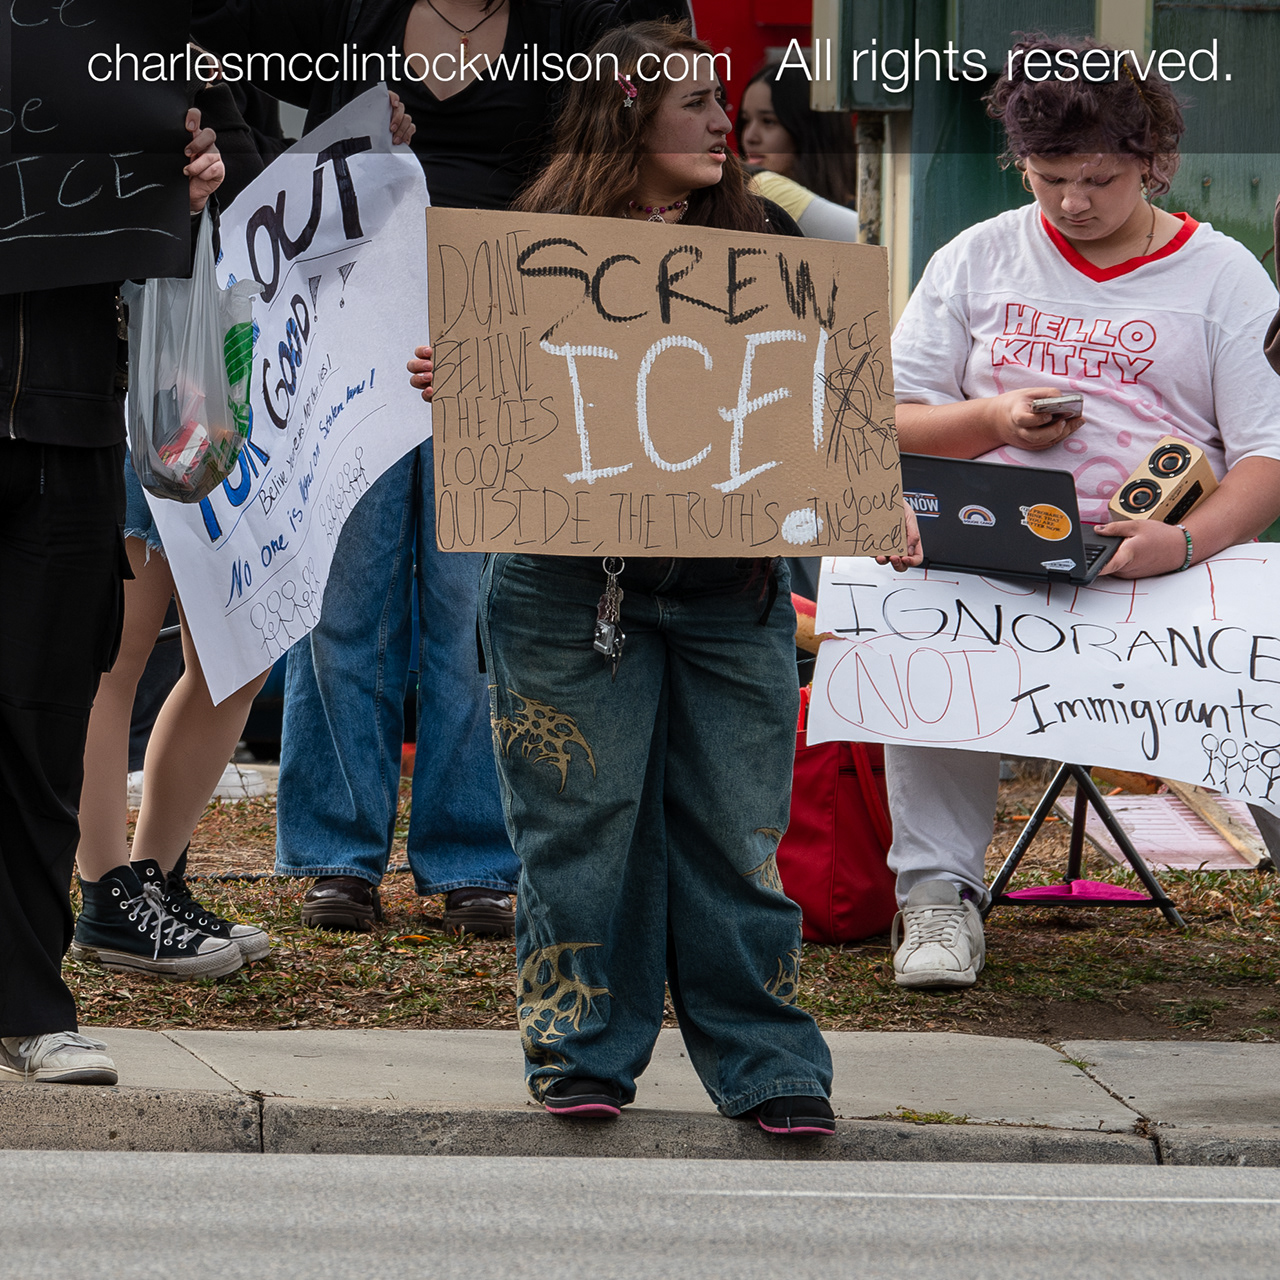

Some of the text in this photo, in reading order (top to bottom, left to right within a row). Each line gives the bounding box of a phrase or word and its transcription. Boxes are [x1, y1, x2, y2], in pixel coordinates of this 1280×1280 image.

[244, 135, 373, 305] OUT
[432, 230, 532, 342] DONT
[516, 238, 840, 345] SCREW
[990, 336, 1155, 384] KITTY
[1002, 303, 1158, 356] HELLO
[434, 396, 486, 443] THE
[225, 556, 252, 608] No
[261, 533, 289, 568] one
[289, 506, 303, 532] is
[313, 443, 321, 465] on
[319, 401, 344, 440] Stolen
[441, 444, 533, 490] LOOK
[611, 493, 661, 549] THE
[810, 497, 841, 547] IN
[831, 582, 1280, 685] IGNORANCE
[855, 647, 998, 736] NOT
[1010, 683, 1280, 761] Immigrants
